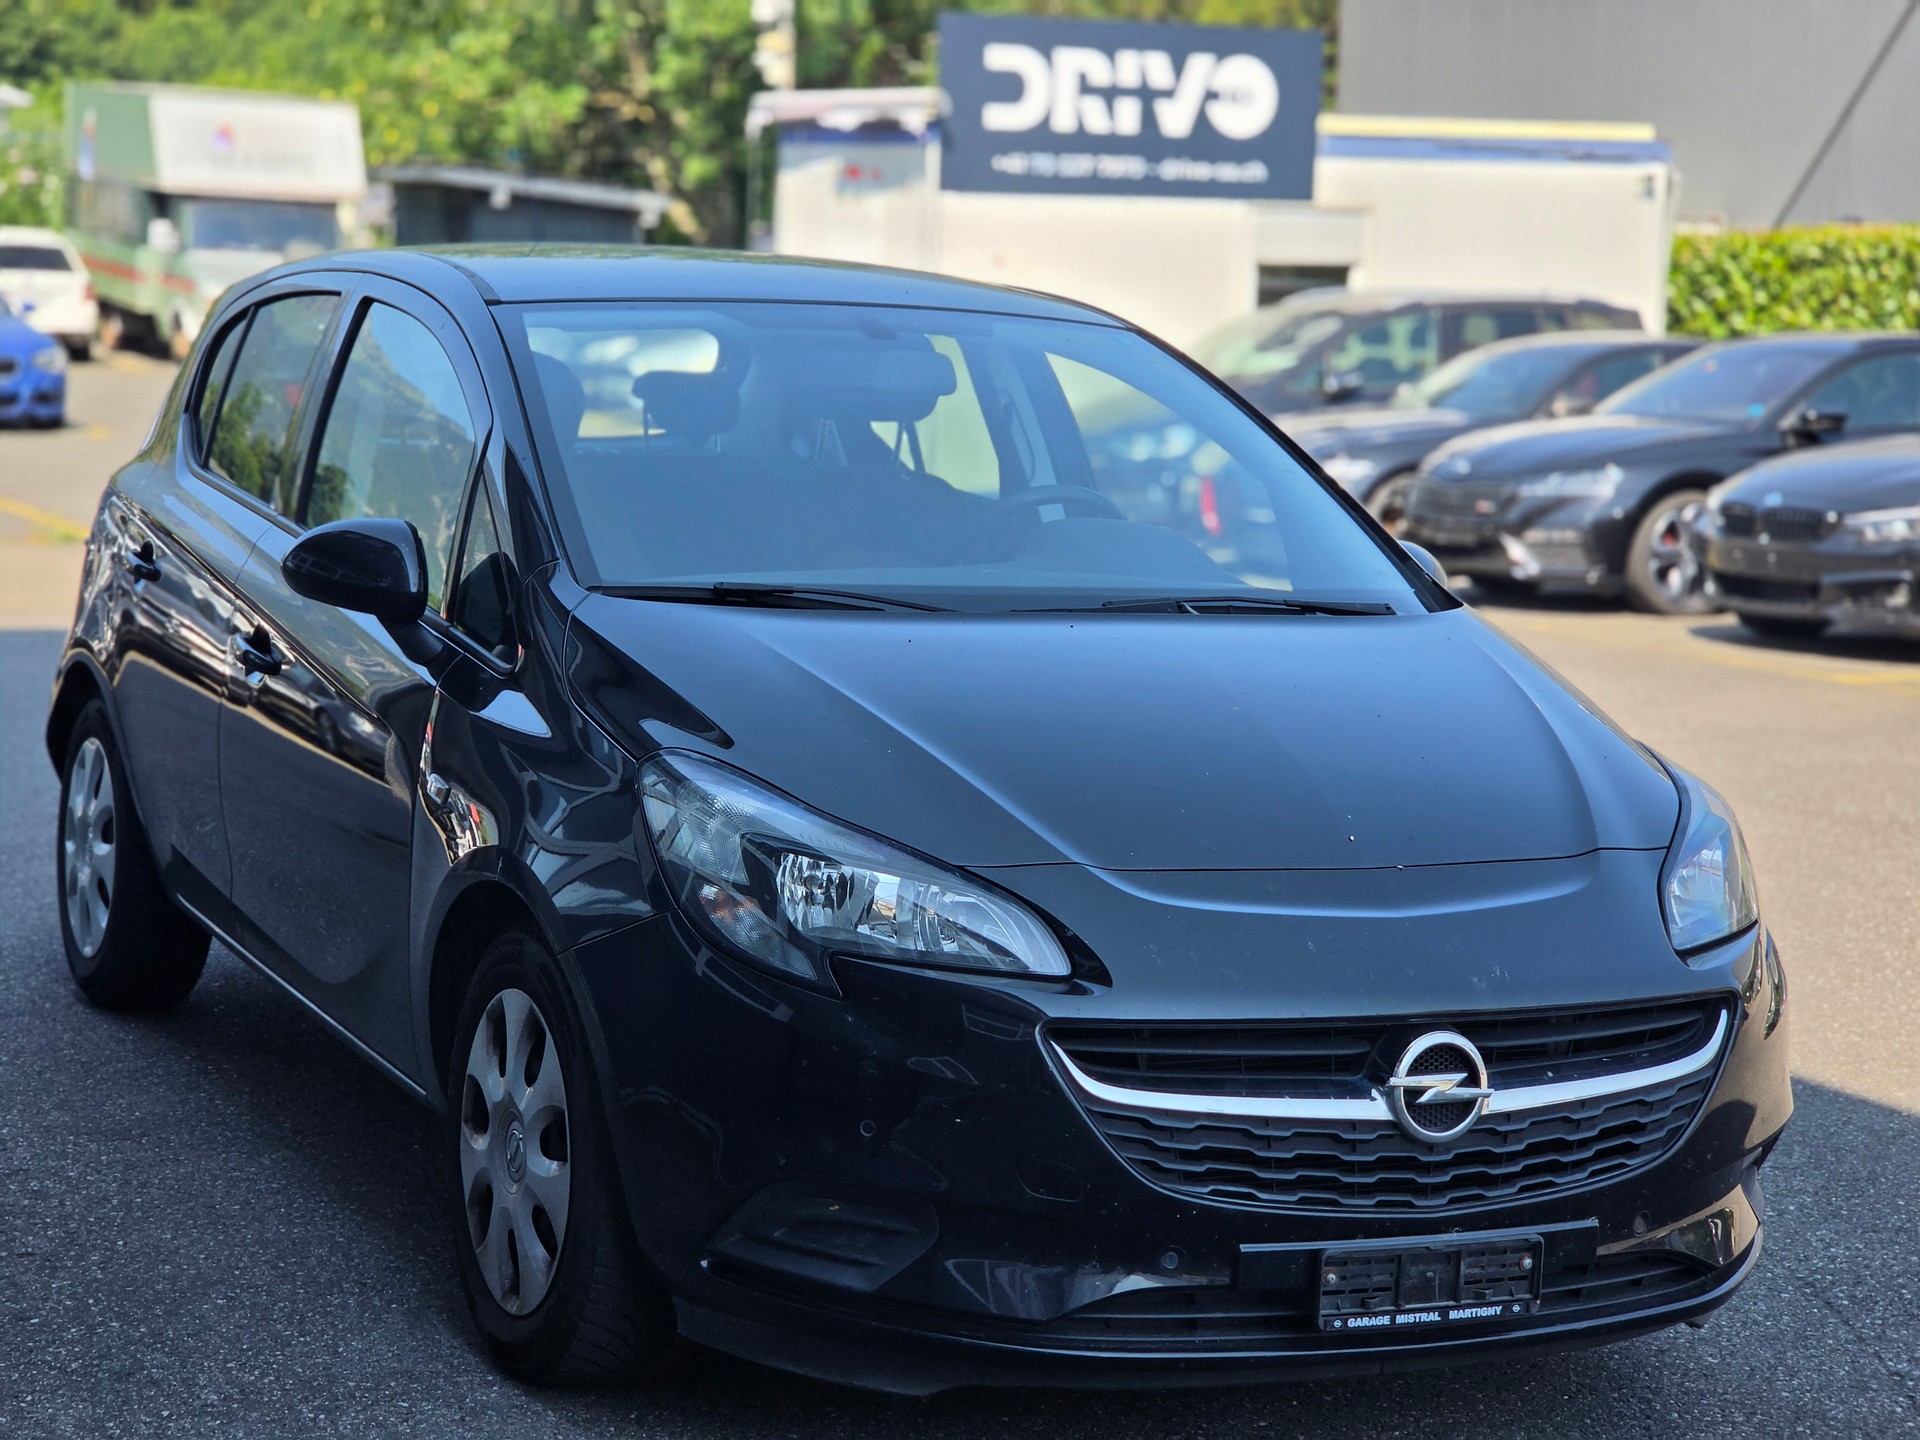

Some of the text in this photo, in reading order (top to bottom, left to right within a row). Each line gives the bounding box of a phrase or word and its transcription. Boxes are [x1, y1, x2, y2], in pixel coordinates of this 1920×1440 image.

[1347, 1305, 1503, 1328] GARAGE MISTRAL MARTIGNY
